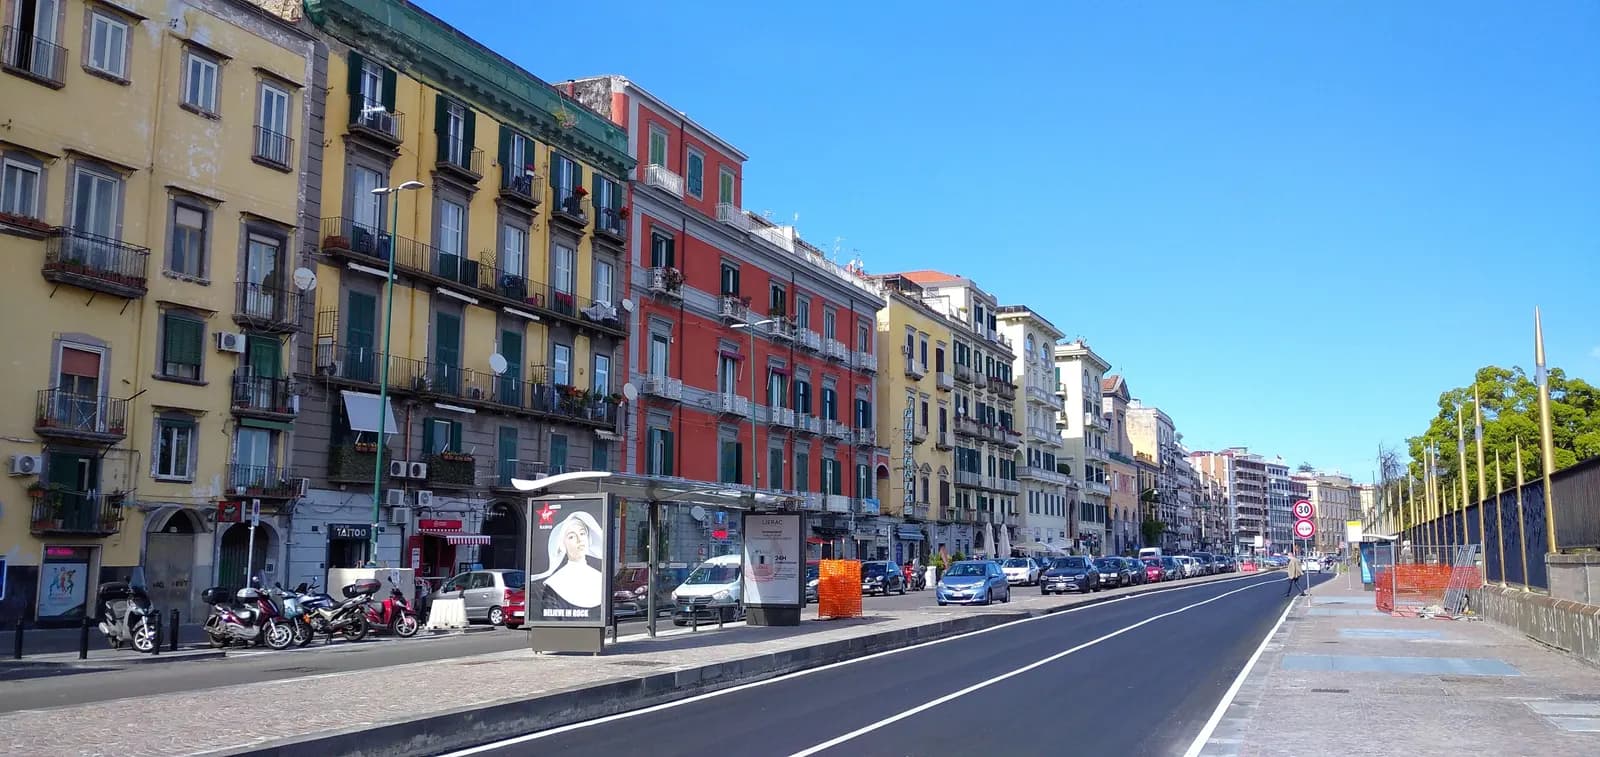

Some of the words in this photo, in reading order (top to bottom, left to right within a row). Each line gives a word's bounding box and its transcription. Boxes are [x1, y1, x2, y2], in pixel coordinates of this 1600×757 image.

[1298, 505, 1310, 514] 30
[336, 528, 367, 537] TATTOO
[543, 608, 565, 617] BELIEVE
[565, 608, 572, 617] IN
[572, 608, 589, 618] ROCK
